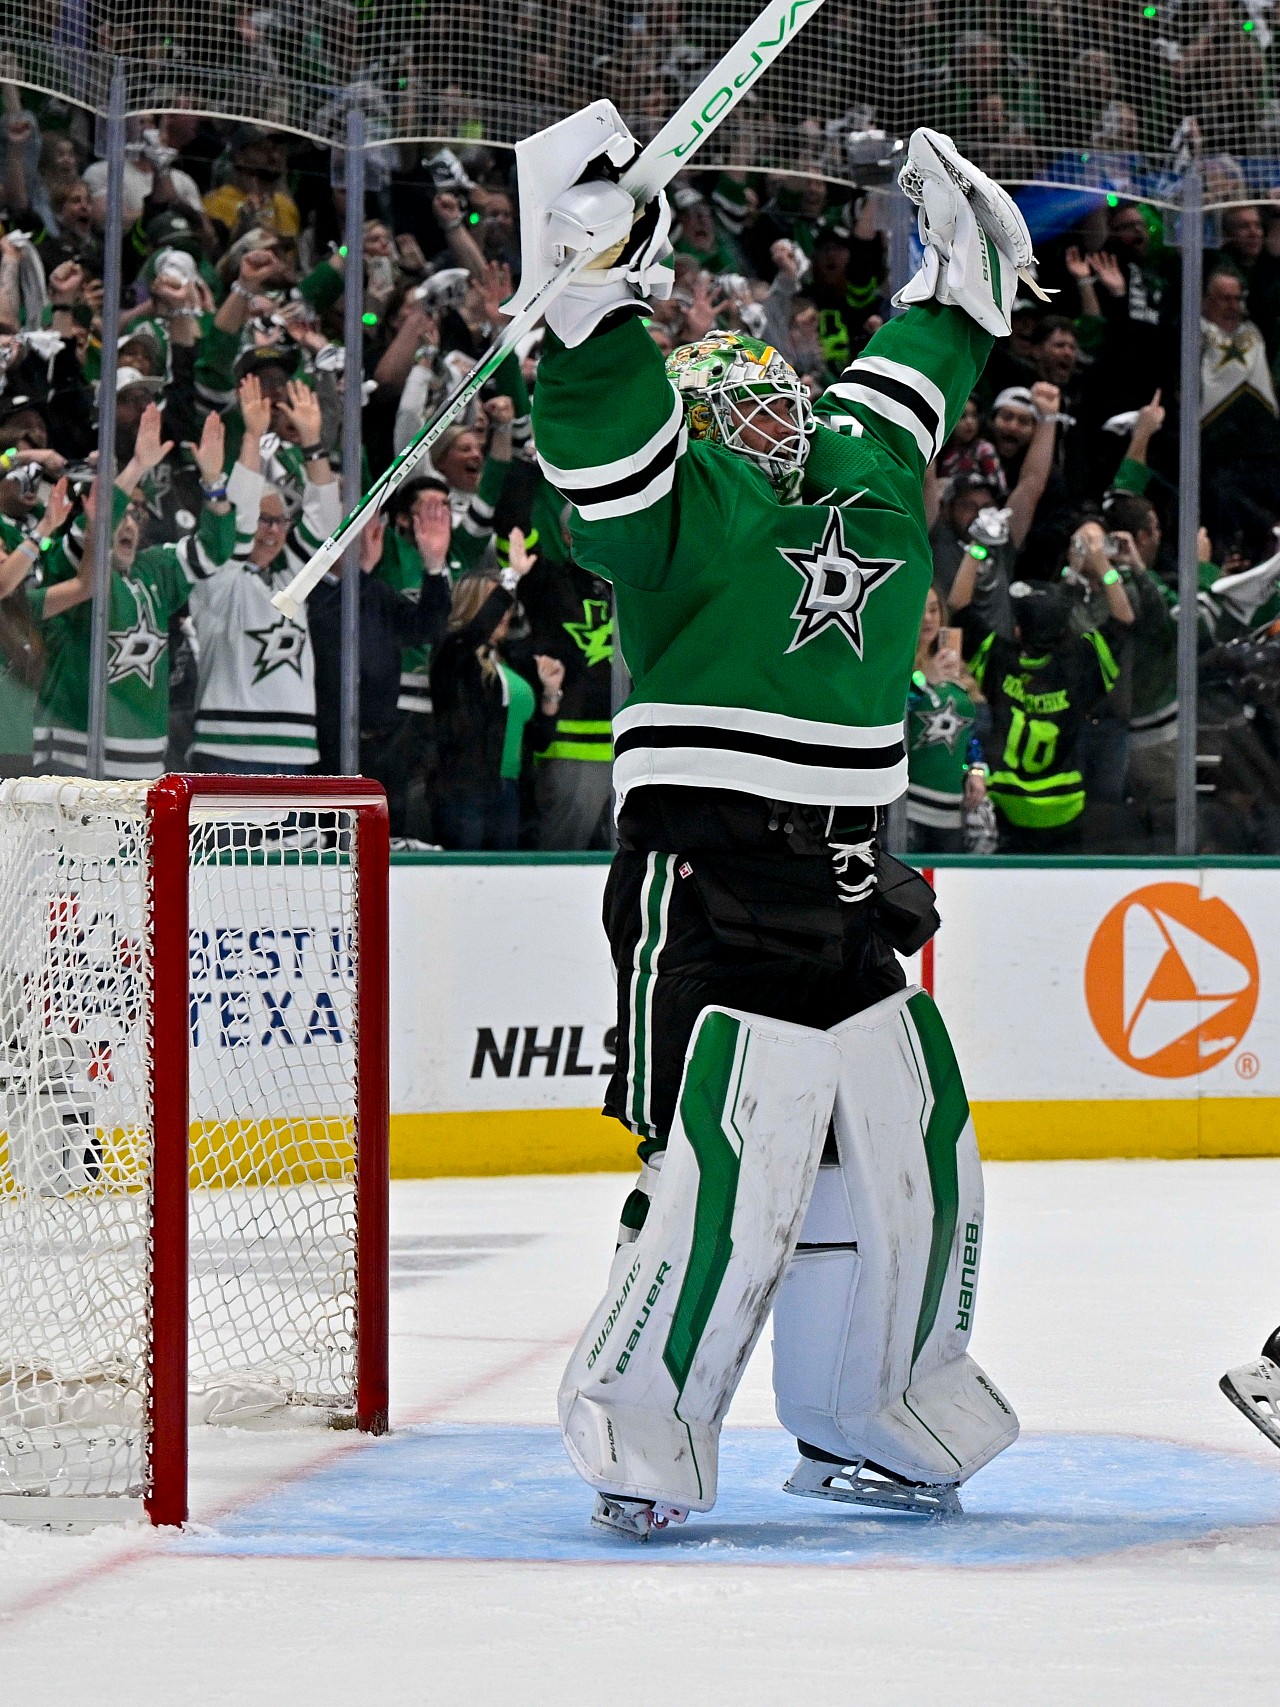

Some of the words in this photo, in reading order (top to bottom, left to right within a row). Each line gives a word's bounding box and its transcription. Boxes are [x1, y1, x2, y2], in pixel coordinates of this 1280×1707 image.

[1003, 705, 1060, 774] 10
[586, 1254, 641, 1371] SUPREME
[615, 1260, 672, 1375] BAUER
[955, 1222, 979, 1332] BAUER
[976, 1375, 1011, 1415] SHADOW
[607, 1418, 618, 1464] SHADOW
